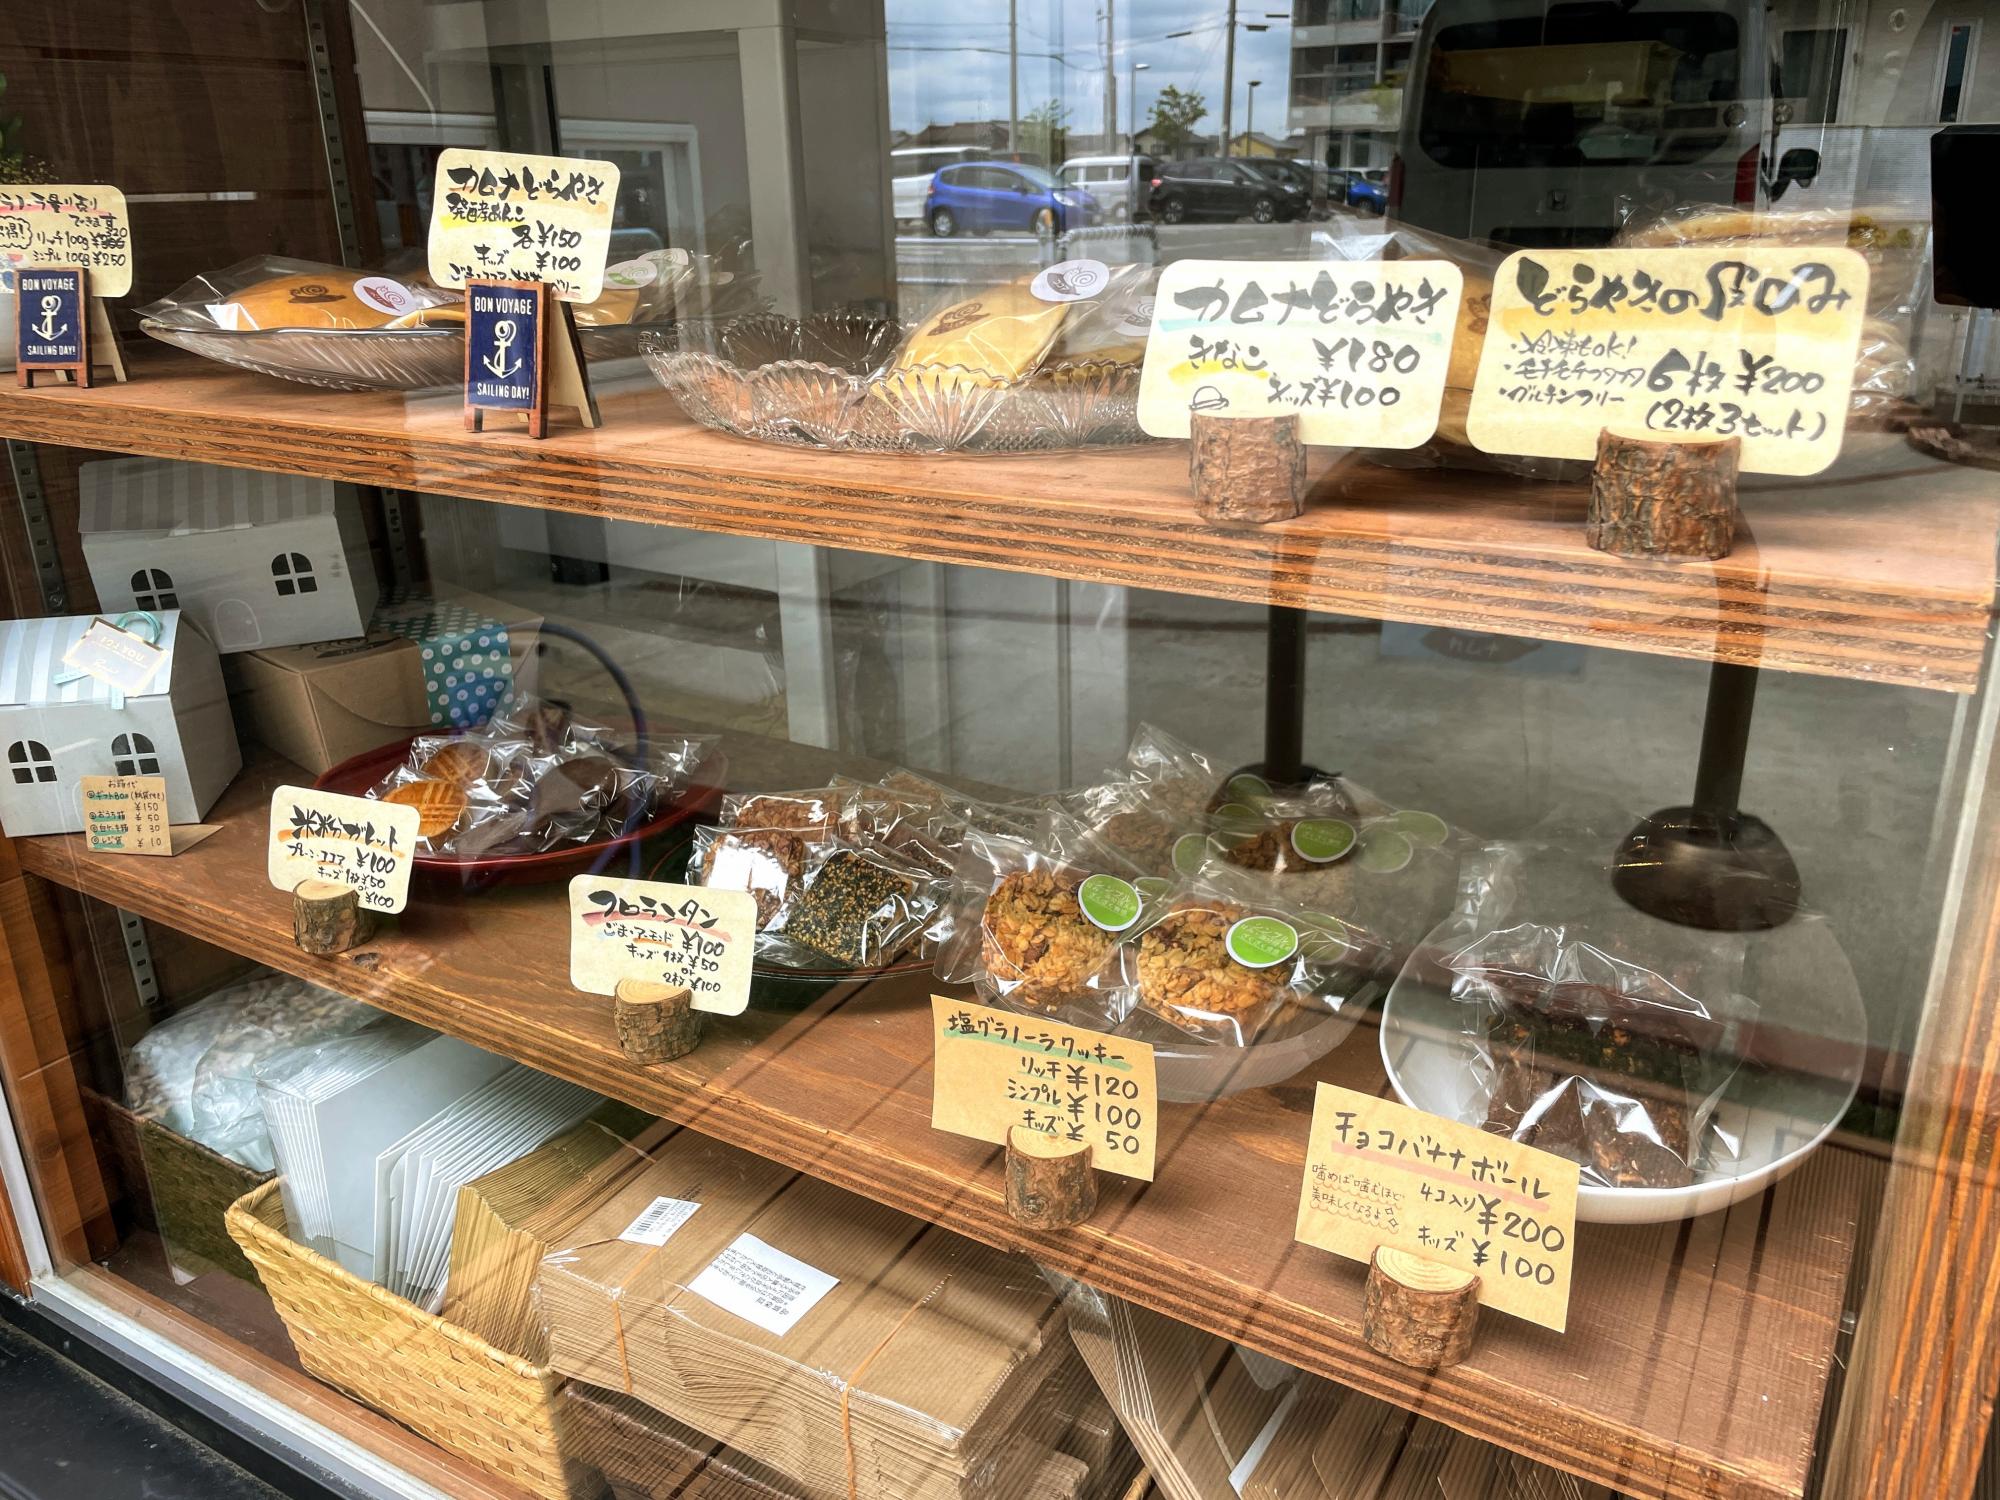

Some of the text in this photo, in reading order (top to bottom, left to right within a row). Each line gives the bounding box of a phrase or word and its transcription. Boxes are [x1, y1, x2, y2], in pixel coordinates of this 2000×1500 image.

[92, 251, 126, 267] ¥250
[535, 250, 582, 271] ¥100
[22, 278, 75, 291] BON VOYAGE
[474, 296, 532, 315] BON VOYAGE
[27, 344, 76, 356] SAILING DAY!
[1187, 334, 1421, 374] きなこ ¥180
[1735, 347, 1825, 396] ¥200
[477, 382, 530, 400] SAILING DAY!
[134, 802, 159, 812] ¥150
[289, 804, 398, 853] 米粉ガレット
[356, 846, 396, 874] ¥100
[365, 891, 394, 909] ¥100
[588, 889, 719, 929] フロランタン
[680, 927, 725, 957] ¥100
[688, 954, 719, 973] ¥50
[690, 976, 721, 993] ¥100
[1021, 1055, 1139, 1100] リッチ ¥120
[1007, 1078, 1142, 1130] シンプル ¥100
[1022, 1108, 1065, 1133] キッズ
[1312, 1162, 1405, 1201] 噛めば噛むほど
[1475, 1193, 1565, 1253] ¥200
[1417, 1225, 1556, 1286] キッズ ¥100
